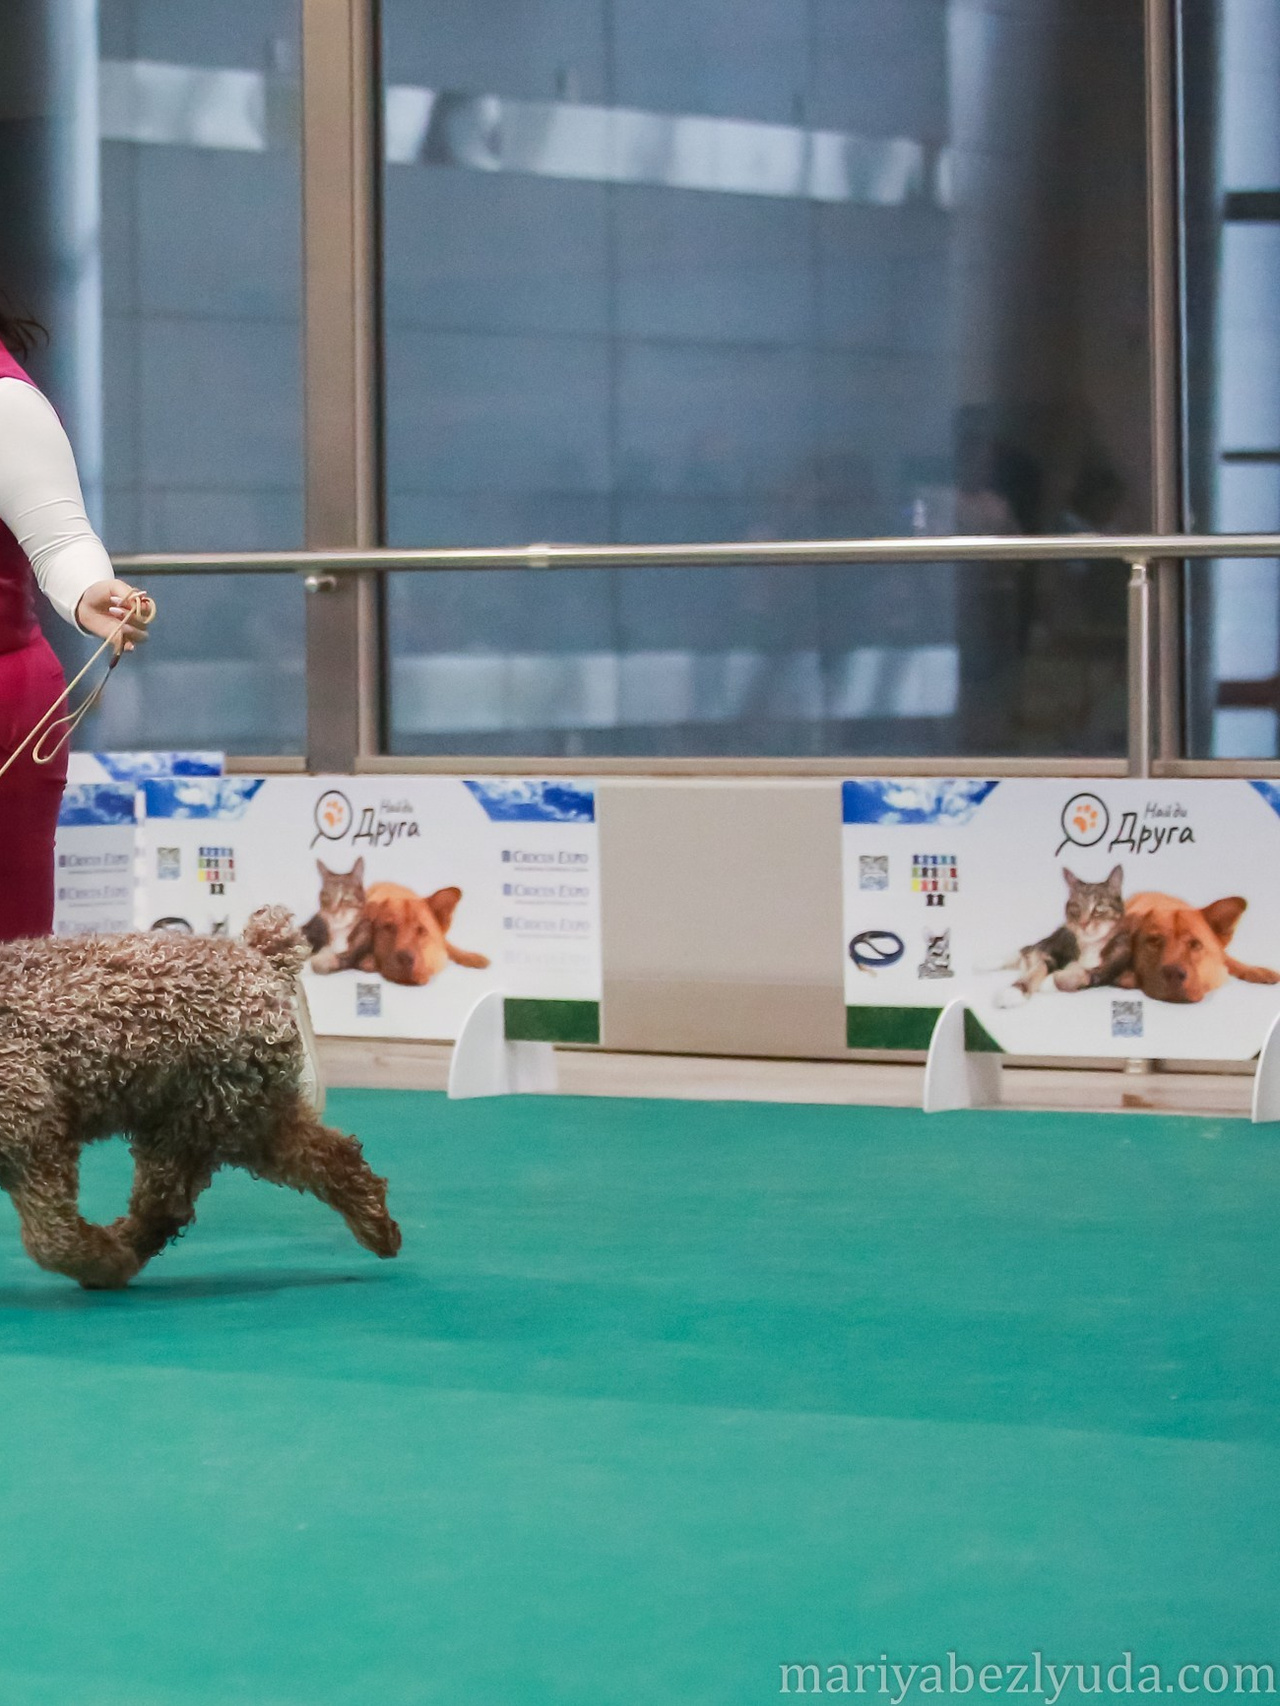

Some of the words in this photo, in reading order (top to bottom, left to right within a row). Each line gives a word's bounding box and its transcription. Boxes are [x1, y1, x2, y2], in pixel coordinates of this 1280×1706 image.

[351, 807, 421, 848] Друга
[1145, 802, 1188, 820] Найди
[1108, 811, 1196, 855] Друга
